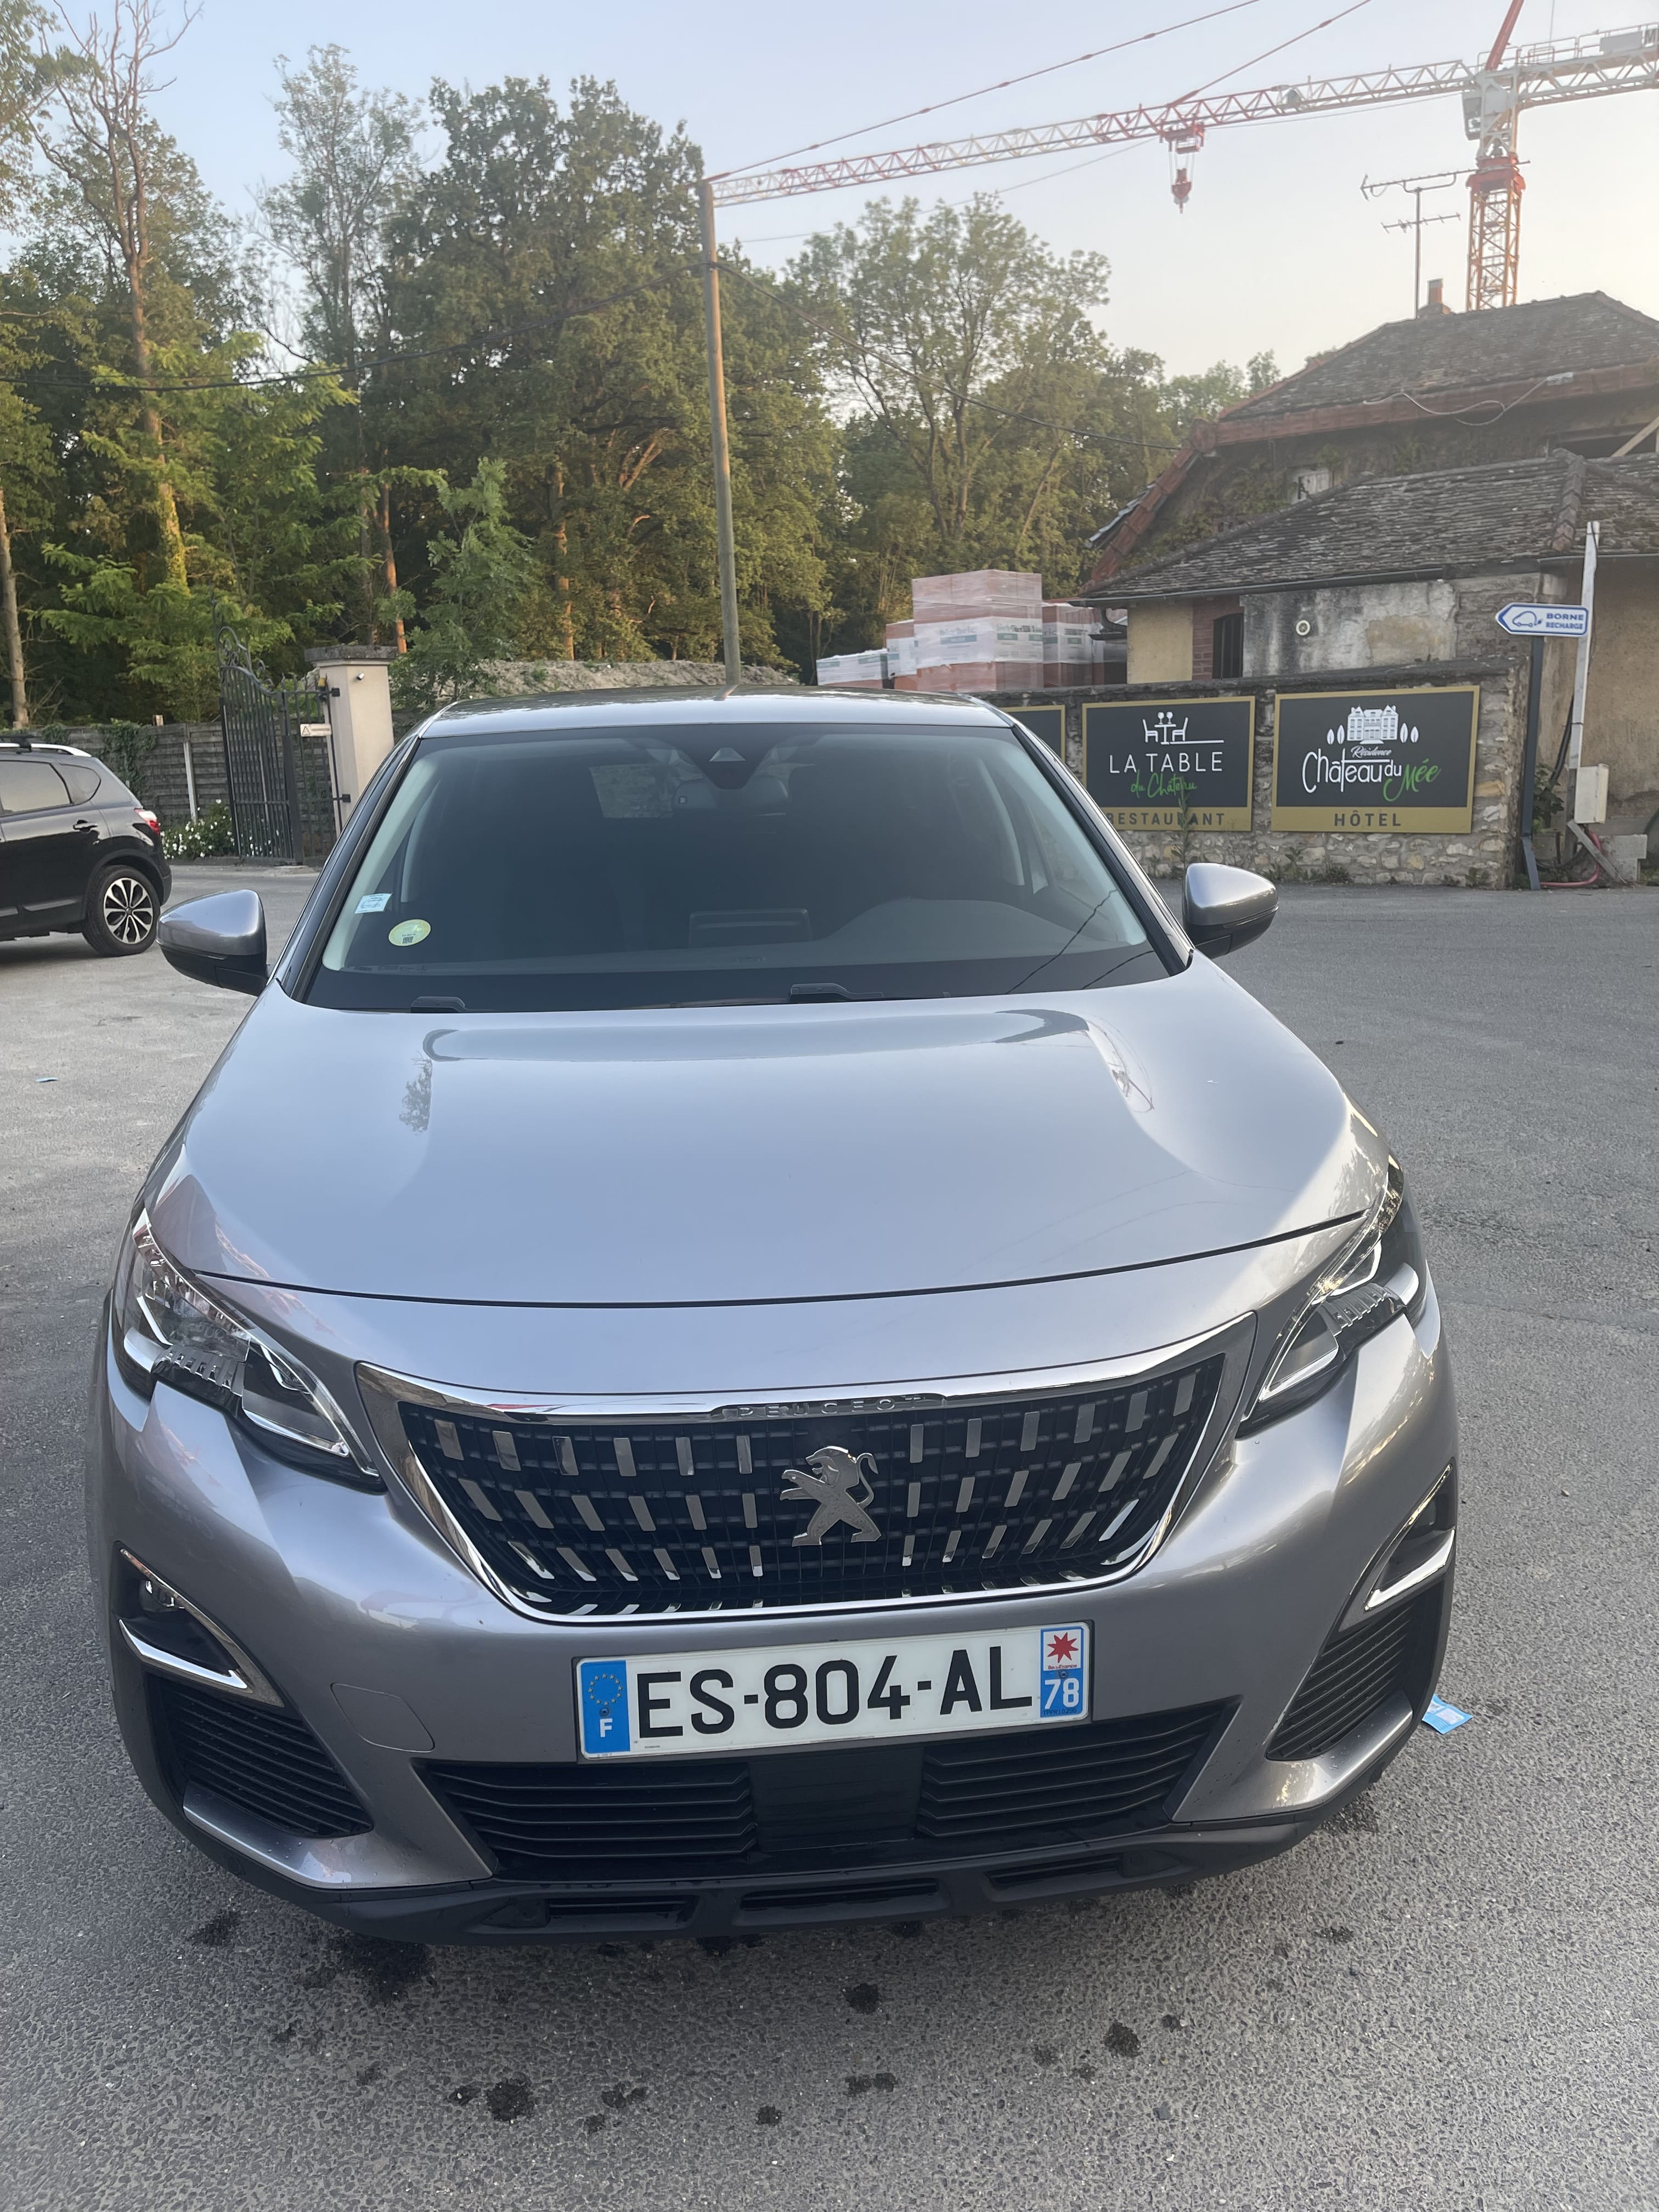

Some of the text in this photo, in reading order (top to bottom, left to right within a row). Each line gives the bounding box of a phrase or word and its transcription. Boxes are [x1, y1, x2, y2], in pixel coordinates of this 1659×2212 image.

[1545, 622, 1583, 630] RECHARGE
[1546, 612, 1584, 620] BORNE
[1350, 745, 1392, 758] Résidence
[1109, 752, 1223, 774] LA TABLE
[1130, 769, 1146, 799] du
[1302, 747, 1442, 802] Château du Mée
[1334, 810, 1402, 827] HÔTEL
[636, 1646, 1033, 1739] ES-804-AL
[1044, 1678, 1080, 1710] 78
[600, 1718, 613, 1738] F
